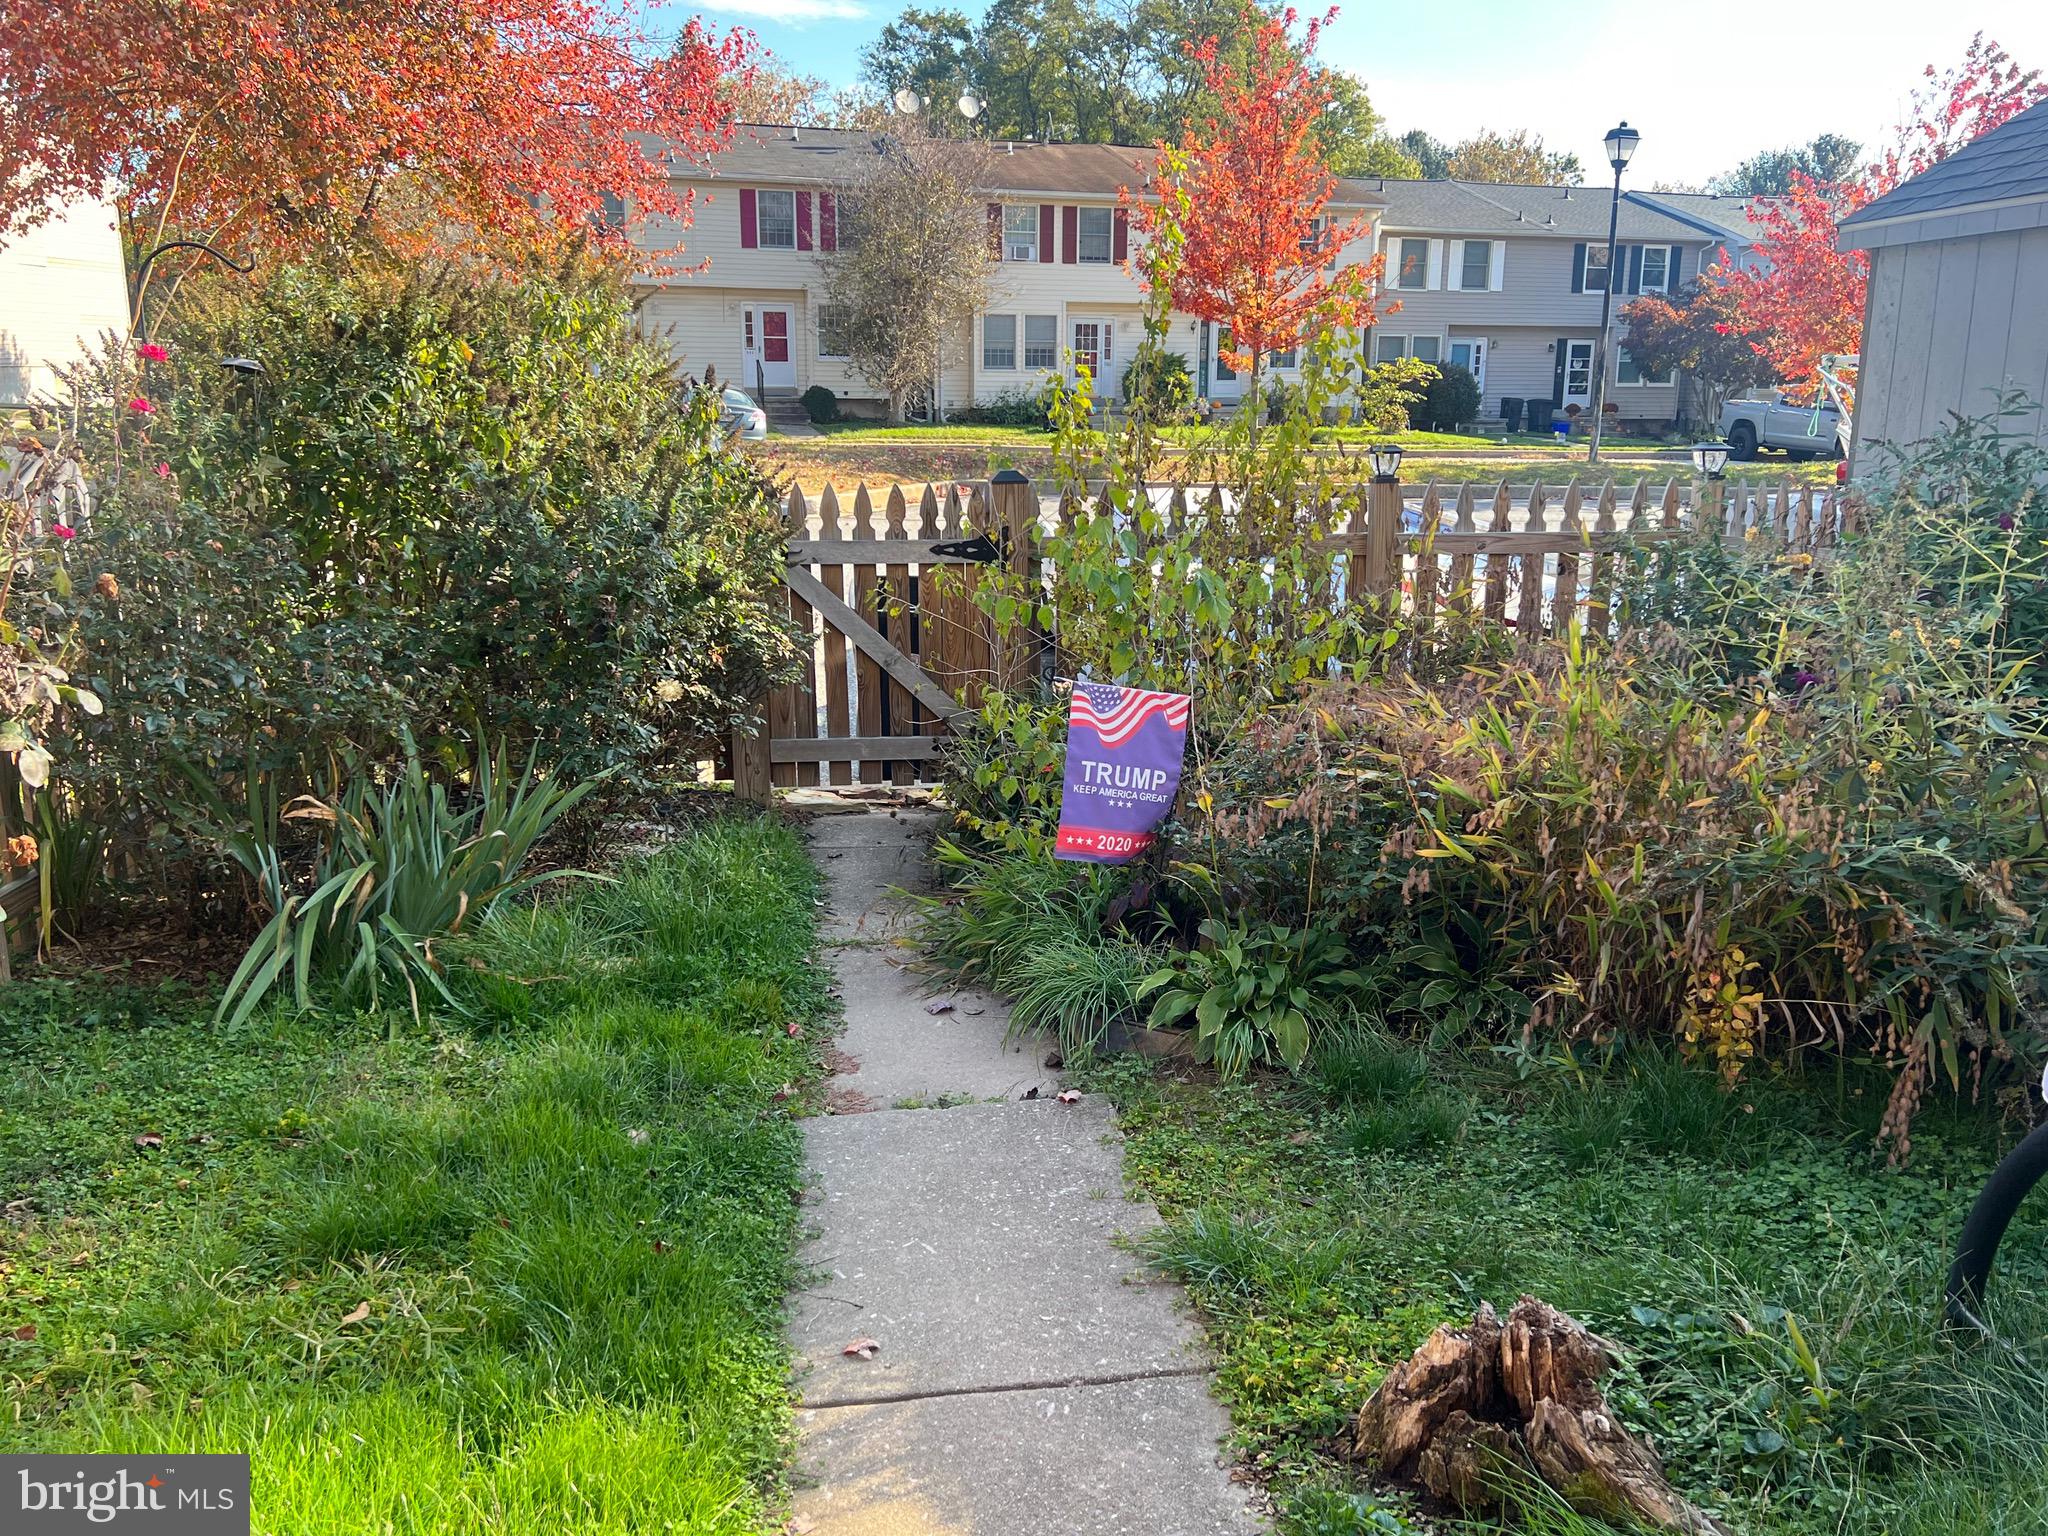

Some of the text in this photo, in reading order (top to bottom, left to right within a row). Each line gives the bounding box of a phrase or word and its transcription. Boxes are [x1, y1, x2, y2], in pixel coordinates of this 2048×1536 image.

[1082, 761, 1167, 791] TRUMP
[1073, 784, 1168, 803] KEEP AMERICA GREAT
[1097, 835, 1132, 852] 2020
